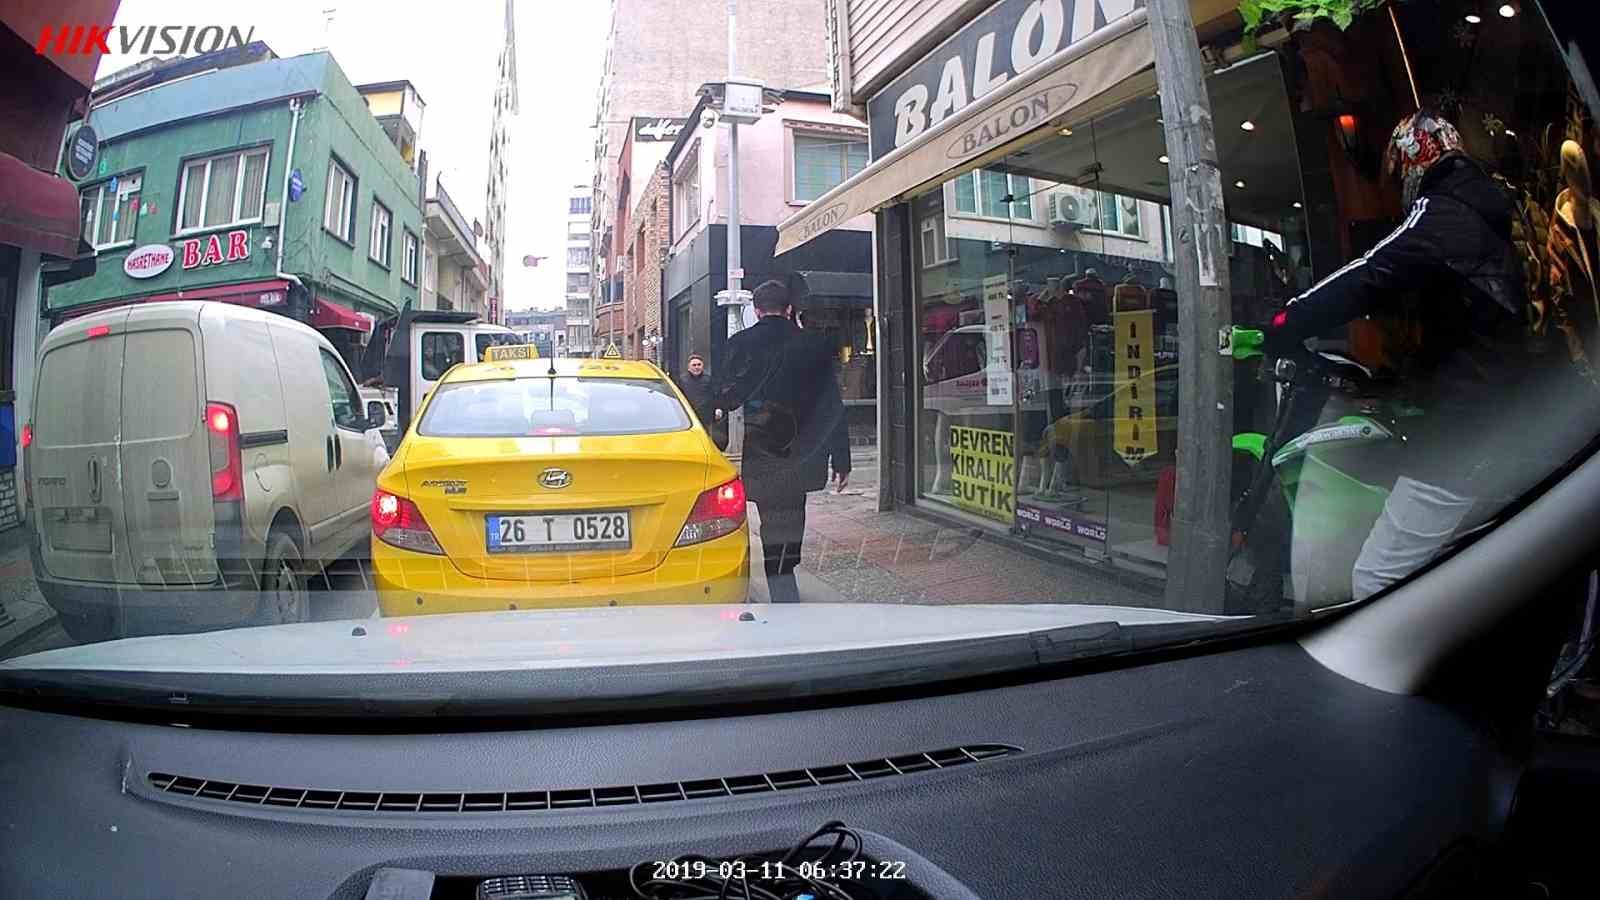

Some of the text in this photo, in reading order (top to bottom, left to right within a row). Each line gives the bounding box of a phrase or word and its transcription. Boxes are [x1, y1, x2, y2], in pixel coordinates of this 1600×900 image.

[961, 92, 1051, 154] BALON
[182, 230, 249, 269] BAR
[950, 428, 1014, 457] DEVREN
[951, 450, 1013, 487] KİRALIK
[951, 479, 1012, 513] BUTİK
[501, 519, 525, 543] 26
[543, 518, 554, 541] T
[573, 516, 625, 540] 0528
[1016, 508, 1040, 522] WORLD
[1044, 516, 1072, 531] WORLD
[1076, 525, 1106, 540] WORLD
